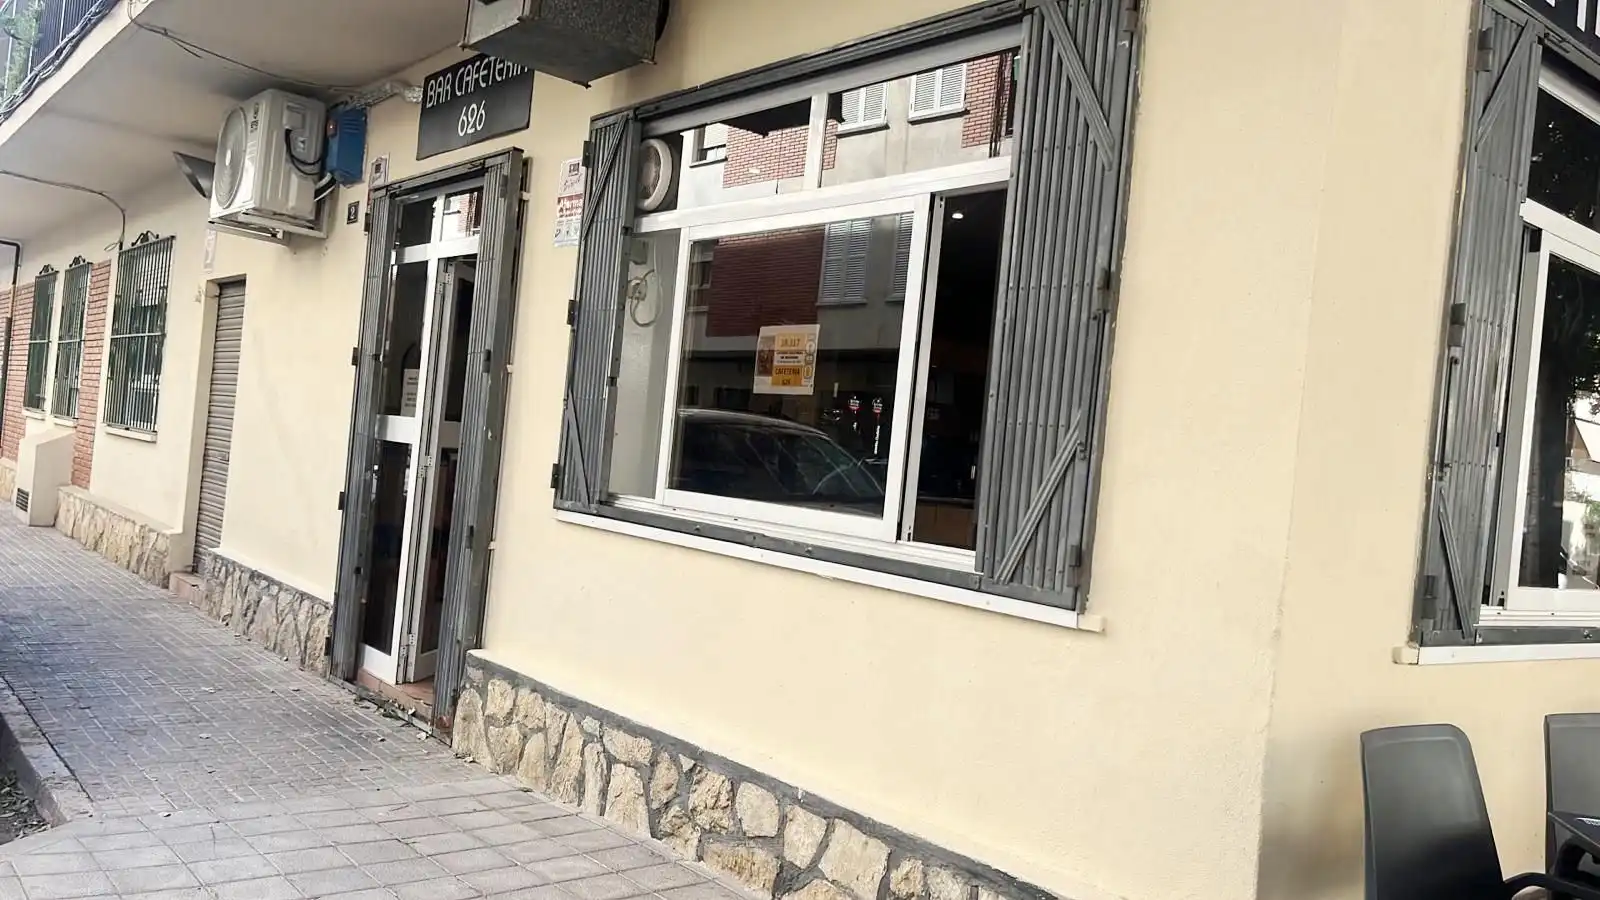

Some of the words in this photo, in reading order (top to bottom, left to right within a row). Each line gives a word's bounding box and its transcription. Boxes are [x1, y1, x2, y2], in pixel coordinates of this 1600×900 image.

[426, 73, 453, 109] BAR
[455, 56, 529, 97] CAFETER
[457, 99, 486, 137] 626
[350, 205, 357, 220] 2
